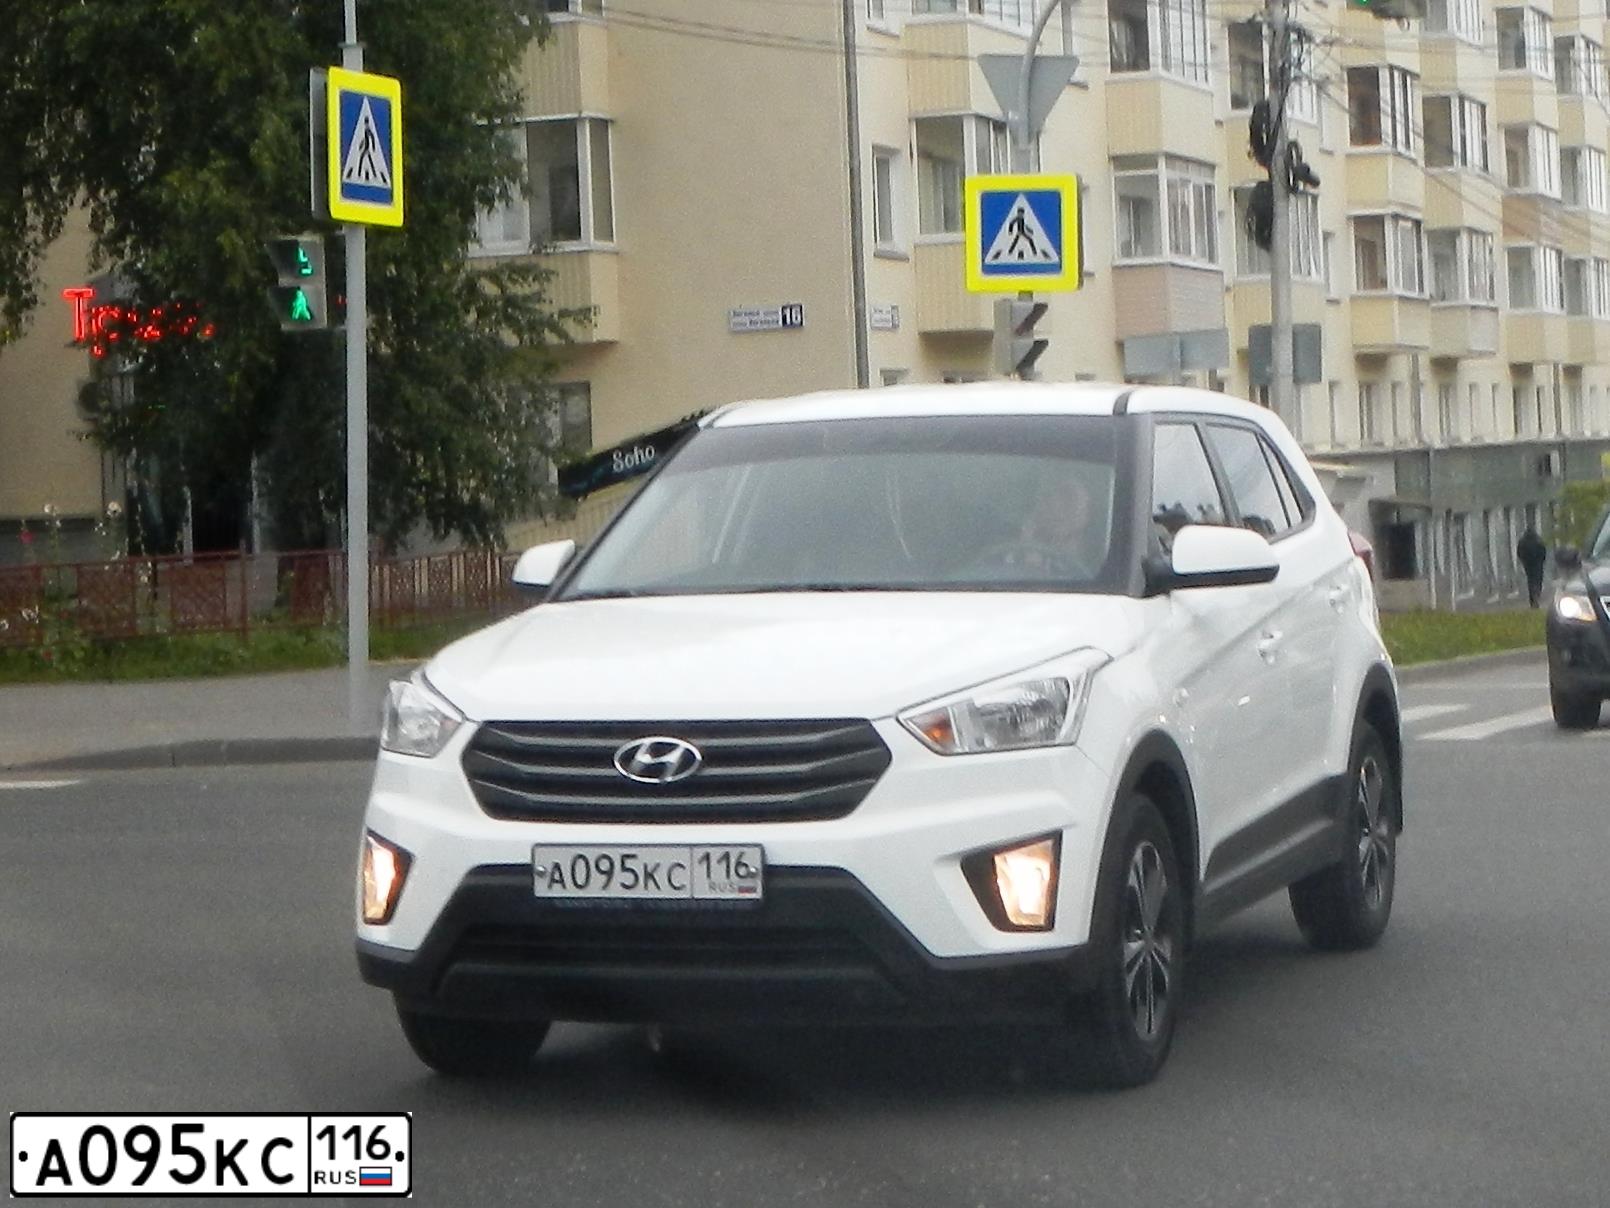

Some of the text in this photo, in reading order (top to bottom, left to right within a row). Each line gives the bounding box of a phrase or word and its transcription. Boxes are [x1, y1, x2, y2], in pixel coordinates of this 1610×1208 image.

[612, 445, 655, 473] Soho
[547, 851, 750, 891] А095КС 116
[708, 881, 736, 893] RUS
